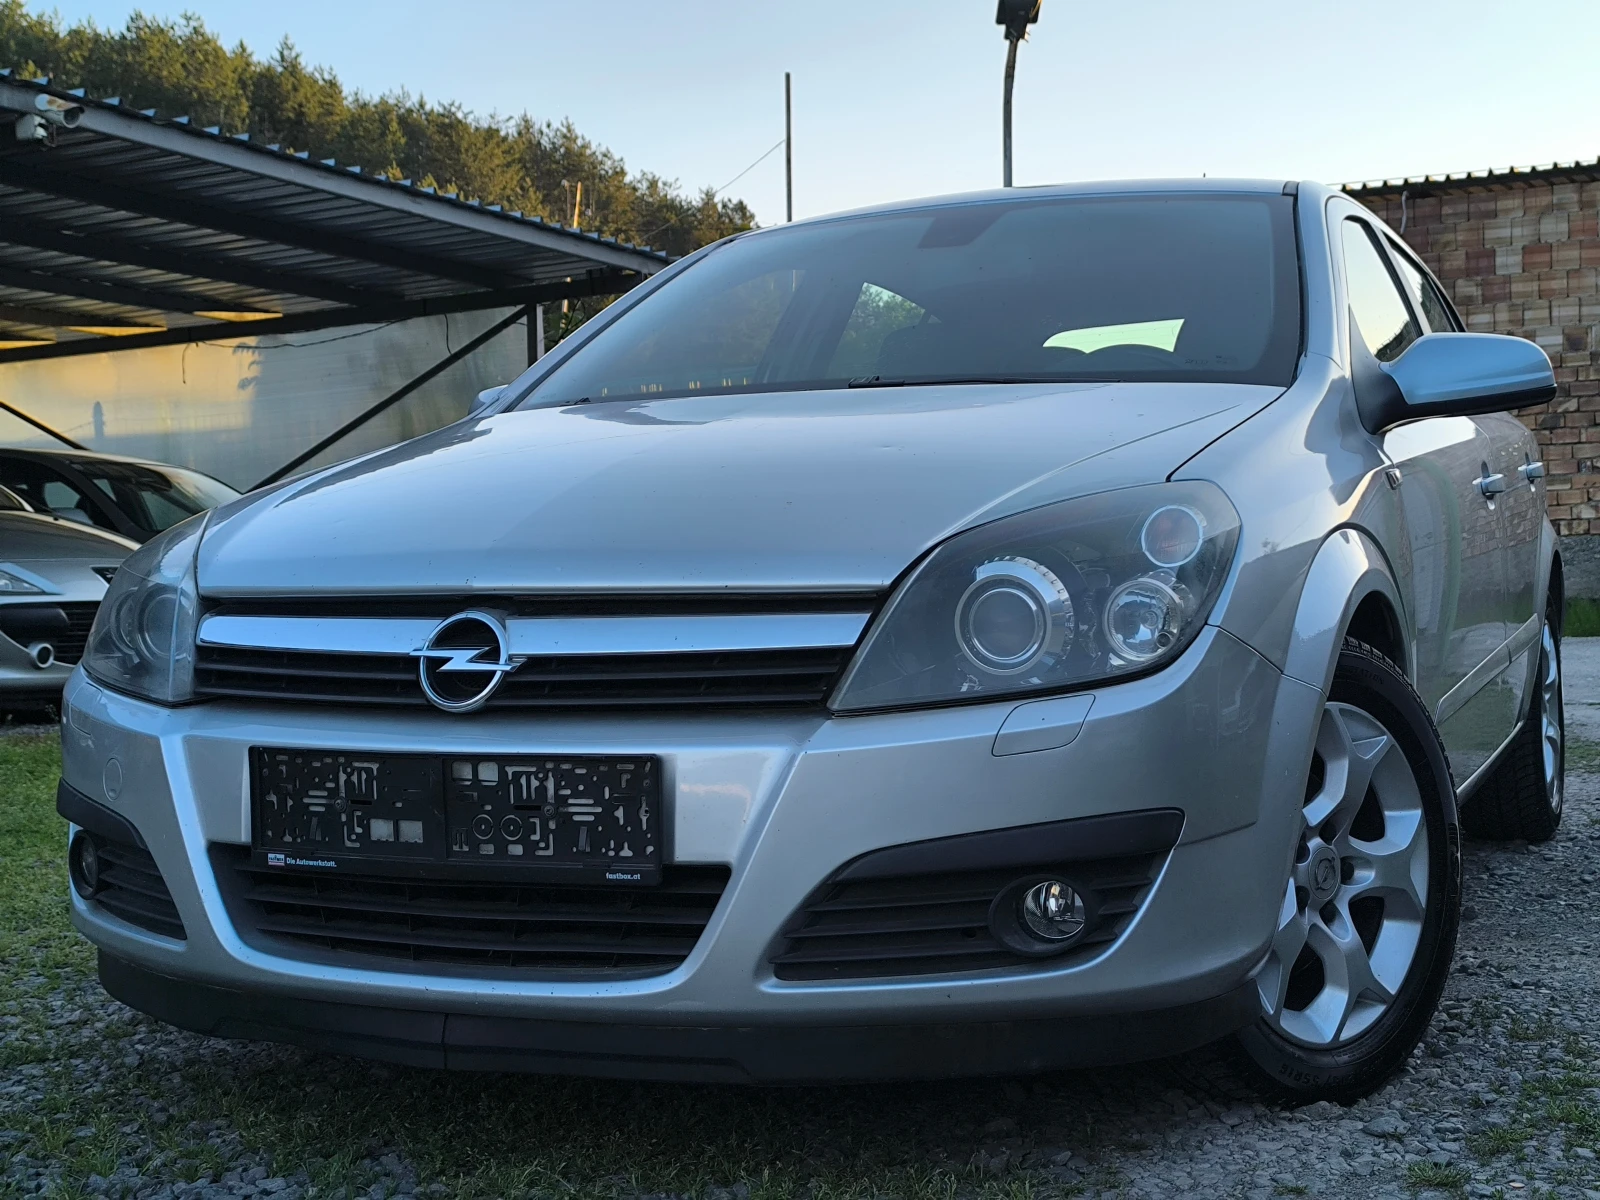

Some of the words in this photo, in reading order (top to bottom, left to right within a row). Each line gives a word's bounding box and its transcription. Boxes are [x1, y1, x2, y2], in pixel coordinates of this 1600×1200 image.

[286, 857, 296, 865] Die
[296, 858, 337, 867] Autowerkstatt.
[605, 872, 640, 880] fastbox.at
